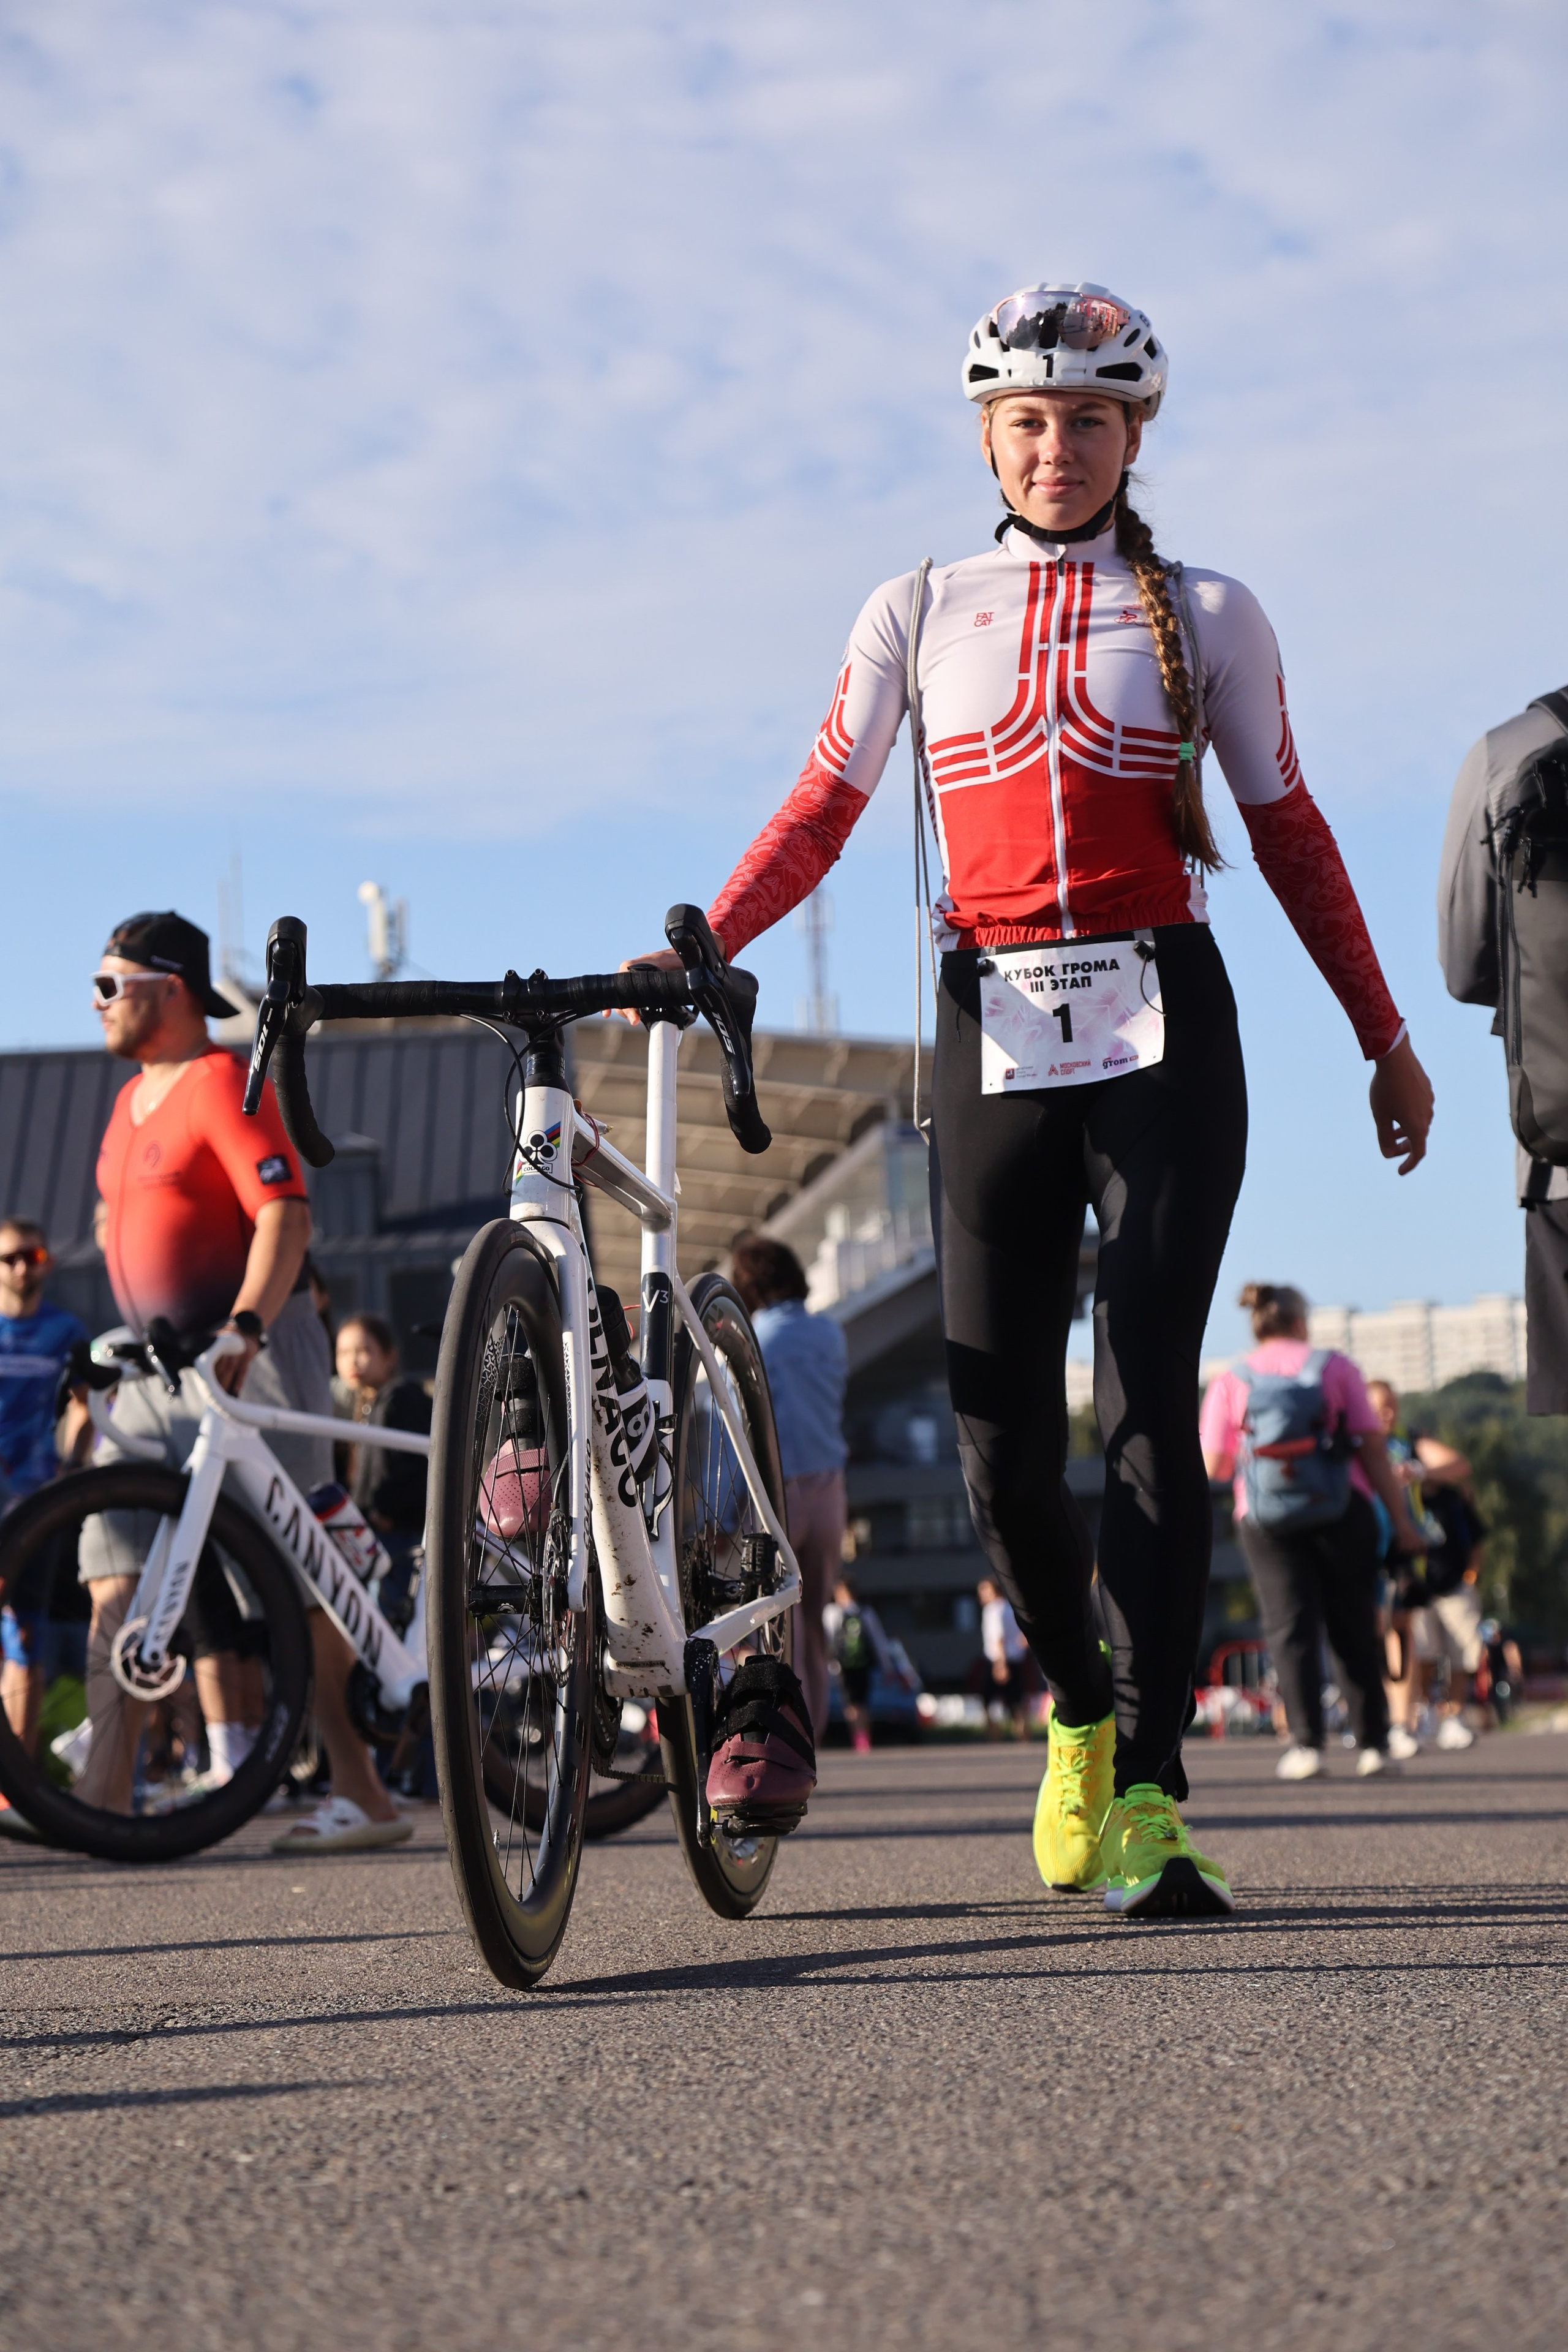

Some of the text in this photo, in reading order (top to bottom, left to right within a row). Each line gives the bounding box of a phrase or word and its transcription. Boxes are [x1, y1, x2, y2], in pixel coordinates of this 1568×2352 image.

[1042, 353, 1054, 378] 1
[1004, 958, 1120, 982] КУБОК ГРОМА
[1030, 975, 1092, 993] III ЭТАП
[712, 1011, 736, 1055] 105
[1052, 1003, 1074, 1043] 1
[254, 1023, 269, 1072] 105
[1102, 1057, 1128, 1069] grom
[579, 1242, 638, 1508] OLNAGO
[265, 1476, 383, 1668] CANYON
